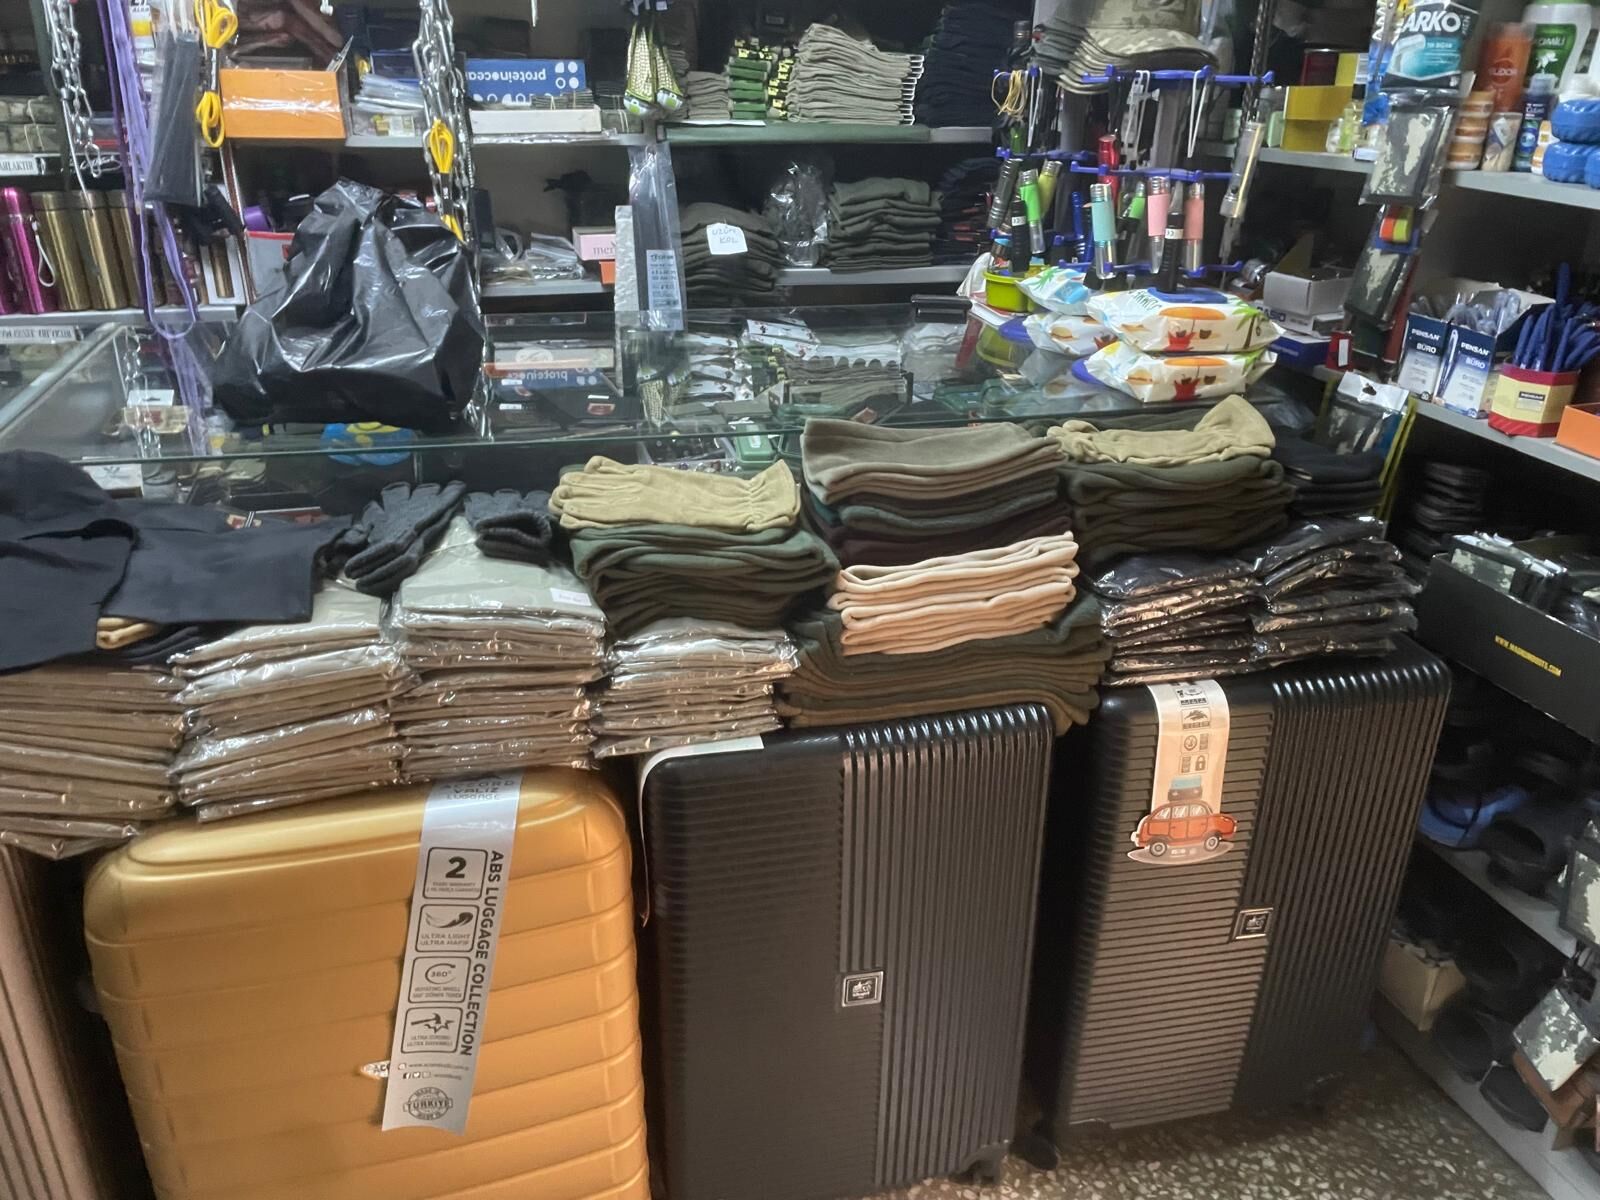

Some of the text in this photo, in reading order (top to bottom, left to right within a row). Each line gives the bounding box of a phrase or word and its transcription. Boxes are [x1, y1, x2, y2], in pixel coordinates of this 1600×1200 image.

[1401, 10, 1461, 33] ARKO
[466, 68, 546, 83] proteinocea
[1411, 328, 1441, 341] PENSAN
[1416, 342, 1437, 354] BÜRO
[1460, 342, 1489, 356] PENSAN
[1466, 356, 1486, 369] BÜRO
[445, 856, 467, 879] 2
[460, 850, 505, 1056] ABS LUGGAGE COLLECTION
